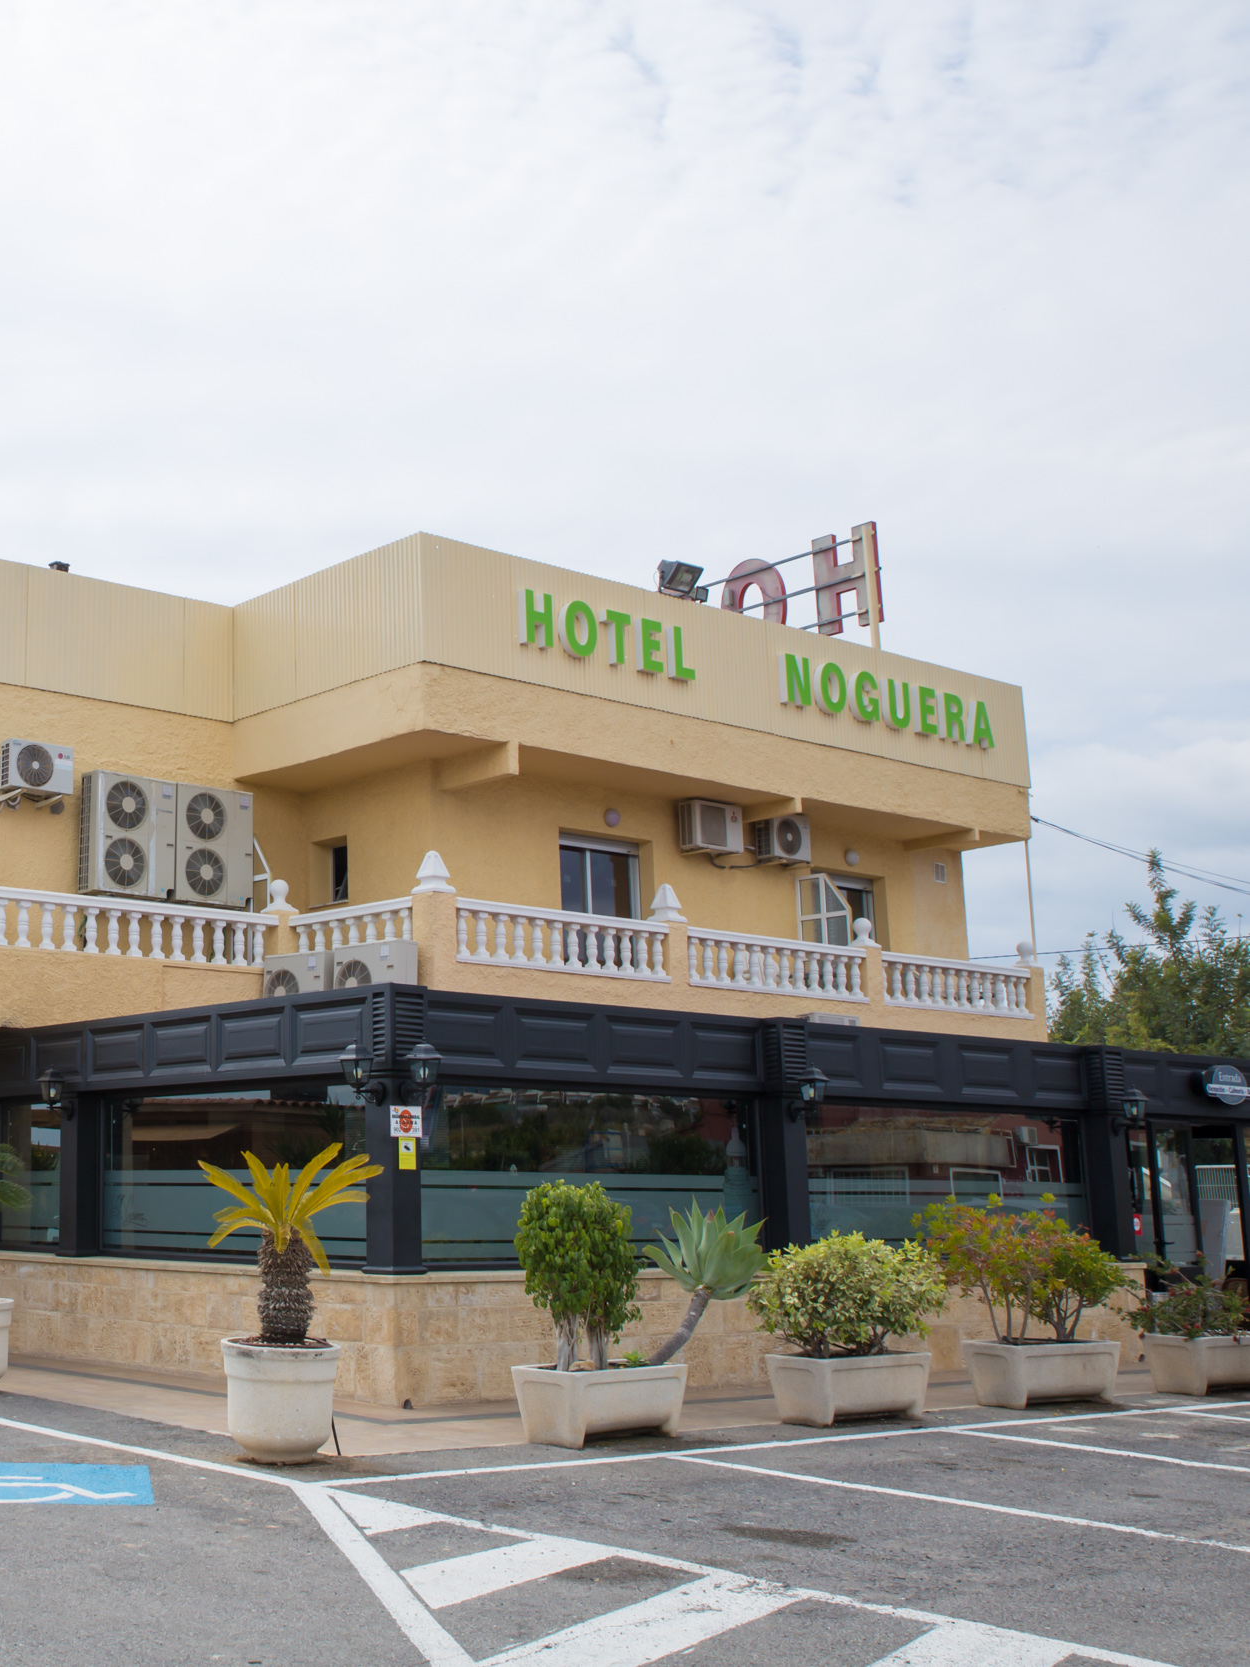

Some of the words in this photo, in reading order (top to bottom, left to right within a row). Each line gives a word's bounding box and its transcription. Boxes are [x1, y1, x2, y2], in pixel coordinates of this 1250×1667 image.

[519, 588, 696, 682] HOTEL
[778, 653, 996, 751] NOGUERA
[1218, 1072, 1242, 1083] Entrada
